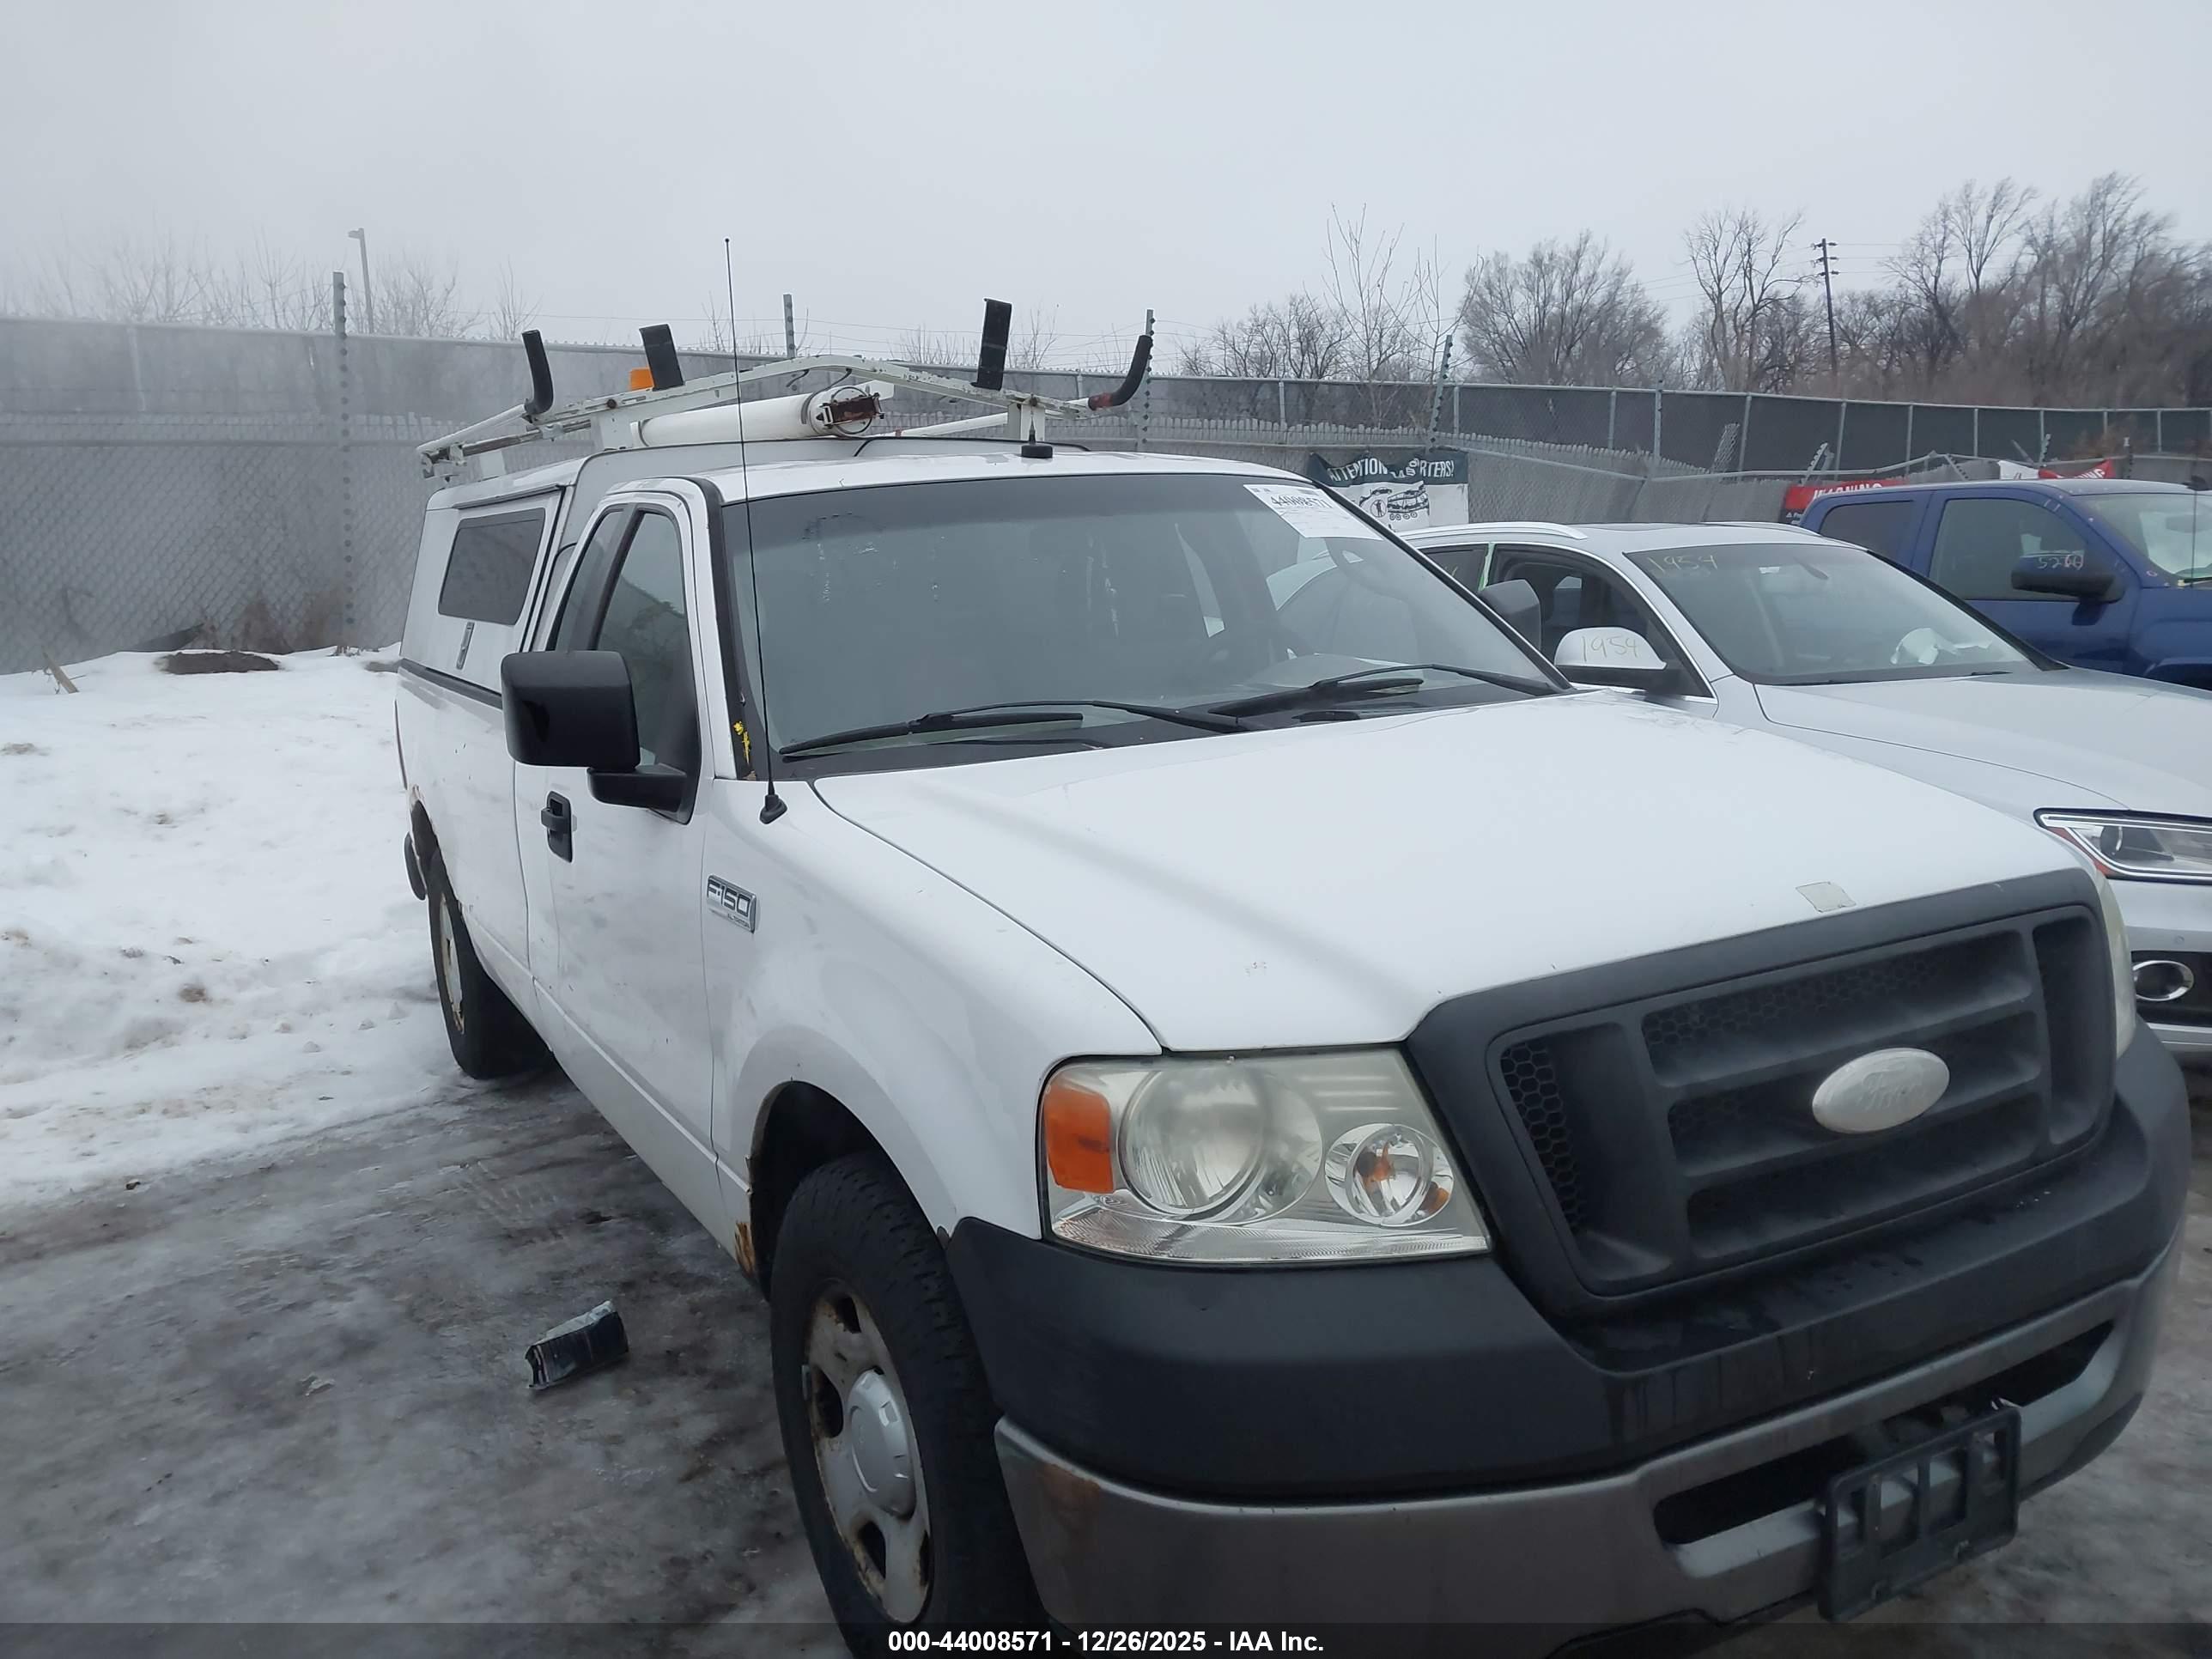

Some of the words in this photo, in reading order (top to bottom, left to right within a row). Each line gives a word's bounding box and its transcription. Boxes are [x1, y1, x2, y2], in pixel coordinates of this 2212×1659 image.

[1328, 458, 1389, 482] ATTENTION
[1647, 554, 1717, 573] 1954
[1582, 635, 1638, 662] 1954
